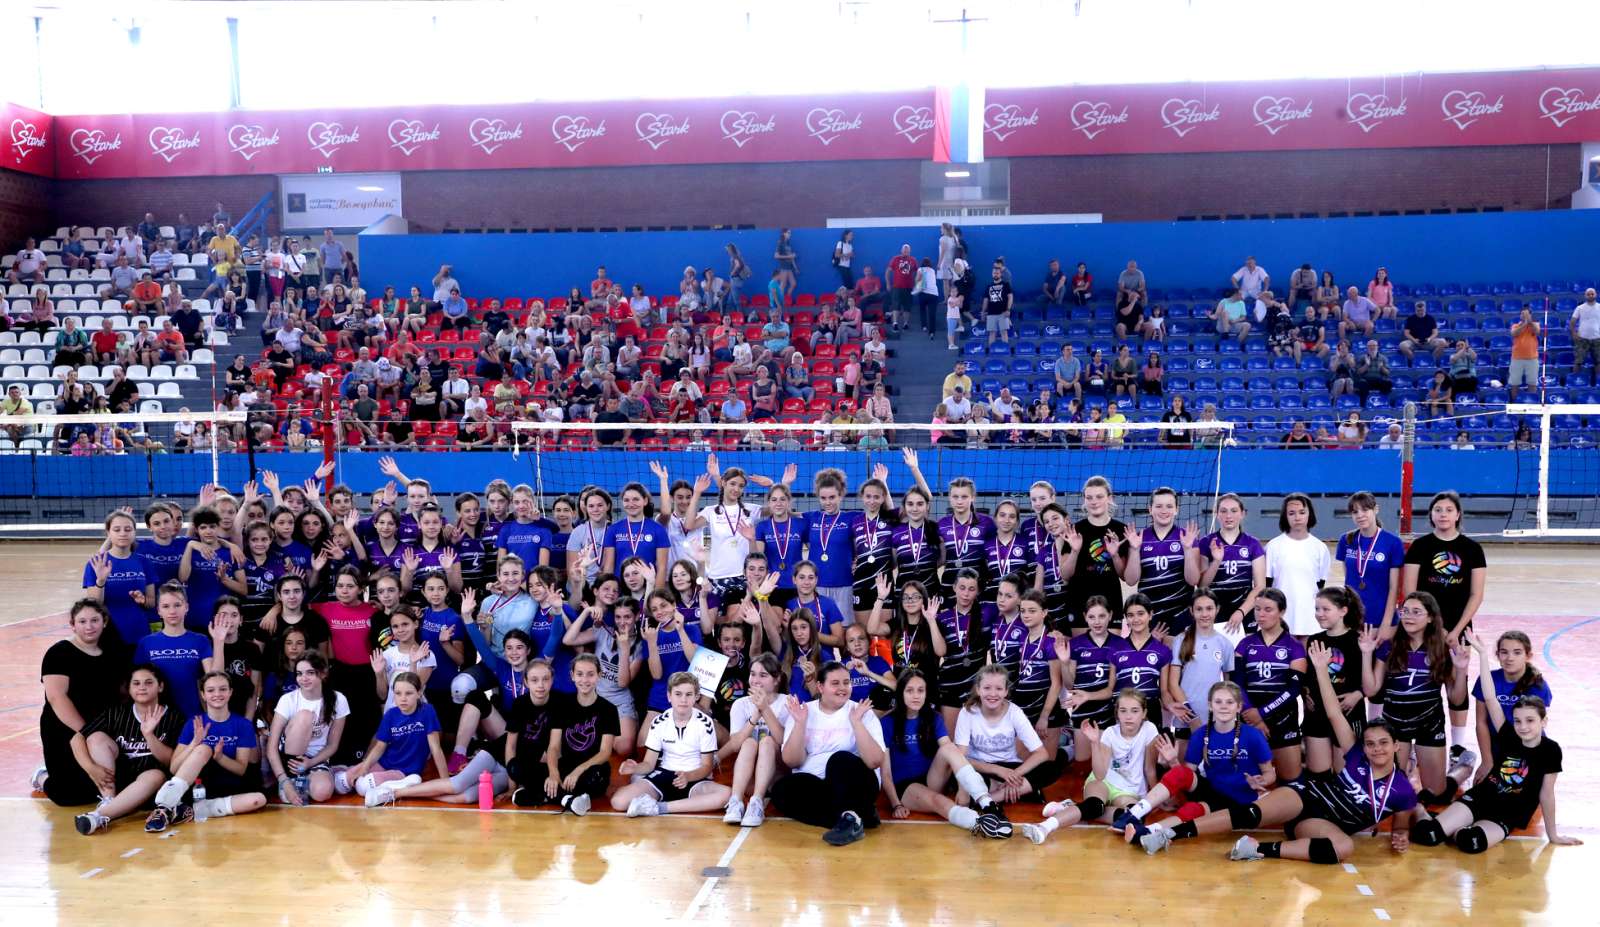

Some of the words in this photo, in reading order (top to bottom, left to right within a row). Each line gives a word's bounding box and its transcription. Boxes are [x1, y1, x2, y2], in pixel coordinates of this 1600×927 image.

[984, 108, 1039, 132] Stark
[1072, 106, 1129, 130] Stark
[1163, 104, 1220, 128] Stark
[1255, 100, 1312, 126] Stark
[1348, 98, 1407, 122] Stark
[1443, 95, 1504, 121] Stark
[391, 123, 440, 147] Stark
[472, 122, 523, 146] Stark
[555, 120, 607, 143] Stark
[638, 117, 689, 141] Stark
[722, 115, 775, 139] Stark
[808, 112, 862, 136] Stark
[12, 130, 46, 147] Stark
[73, 133, 122, 156] Stark
[152, 131, 200, 154] Stark
[231, 128, 279, 152] Stark
[312, 126, 360, 150] Stark
[1153, 556, 1169, 571] 10
[1224, 560, 1238, 575] 18
[149, 648, 199, 657] RODA
[1095, 662, 1105, 678] 5
[1131, 667, 1141, 685] 6
[1256, 662, 1272, 679] 18
[1407, 668, 1417, 686] 7
